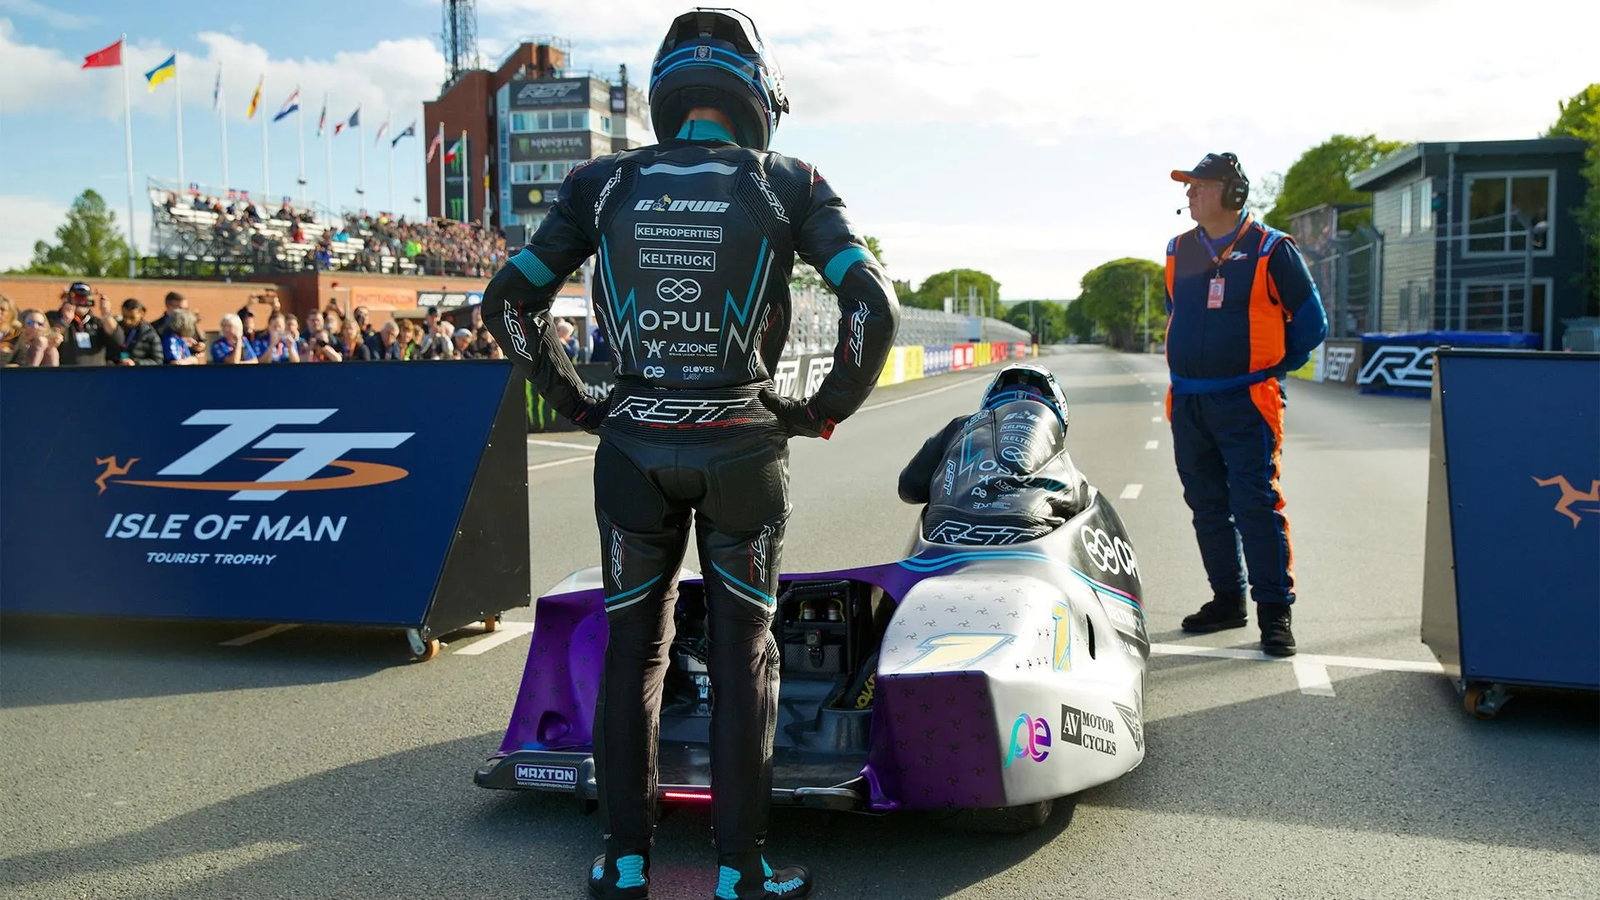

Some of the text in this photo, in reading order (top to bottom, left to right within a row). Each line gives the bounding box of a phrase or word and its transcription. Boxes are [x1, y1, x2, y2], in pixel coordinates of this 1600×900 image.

[530, 137, 583, 149] MONSTER
[637, 226, 720, 240] KELPROPERTIES
[642, 252, 713, 267] KELTRUCK
[503, 299, 533, 361] RST
[638, 309, 720, 332] OPUL
[849, 299, 871, 368] RST
[668, 343, 718, 354] AZIONE
[682, 365, 715, 374] GLOVER
[608, 395, 756, 424] RST
[156, 408, 416, 501] TT
[943, 459, 957, 496] RST
[105, 513, 348, 542] ISLE OF MAN
[927, 519, 1045, 546] RST
[146, 552, 277, 566] TOURIST TROPHY
[611, 528, 624, 591] RST
[751, 523, 776, 583] RST
[1062, 711, 1080, 737] AV
[1082, 710, 1115, 735] MOTOR
[1082, 733, 1117, 757] CYCLES
[518, 767, 574, 781] MAXTON
